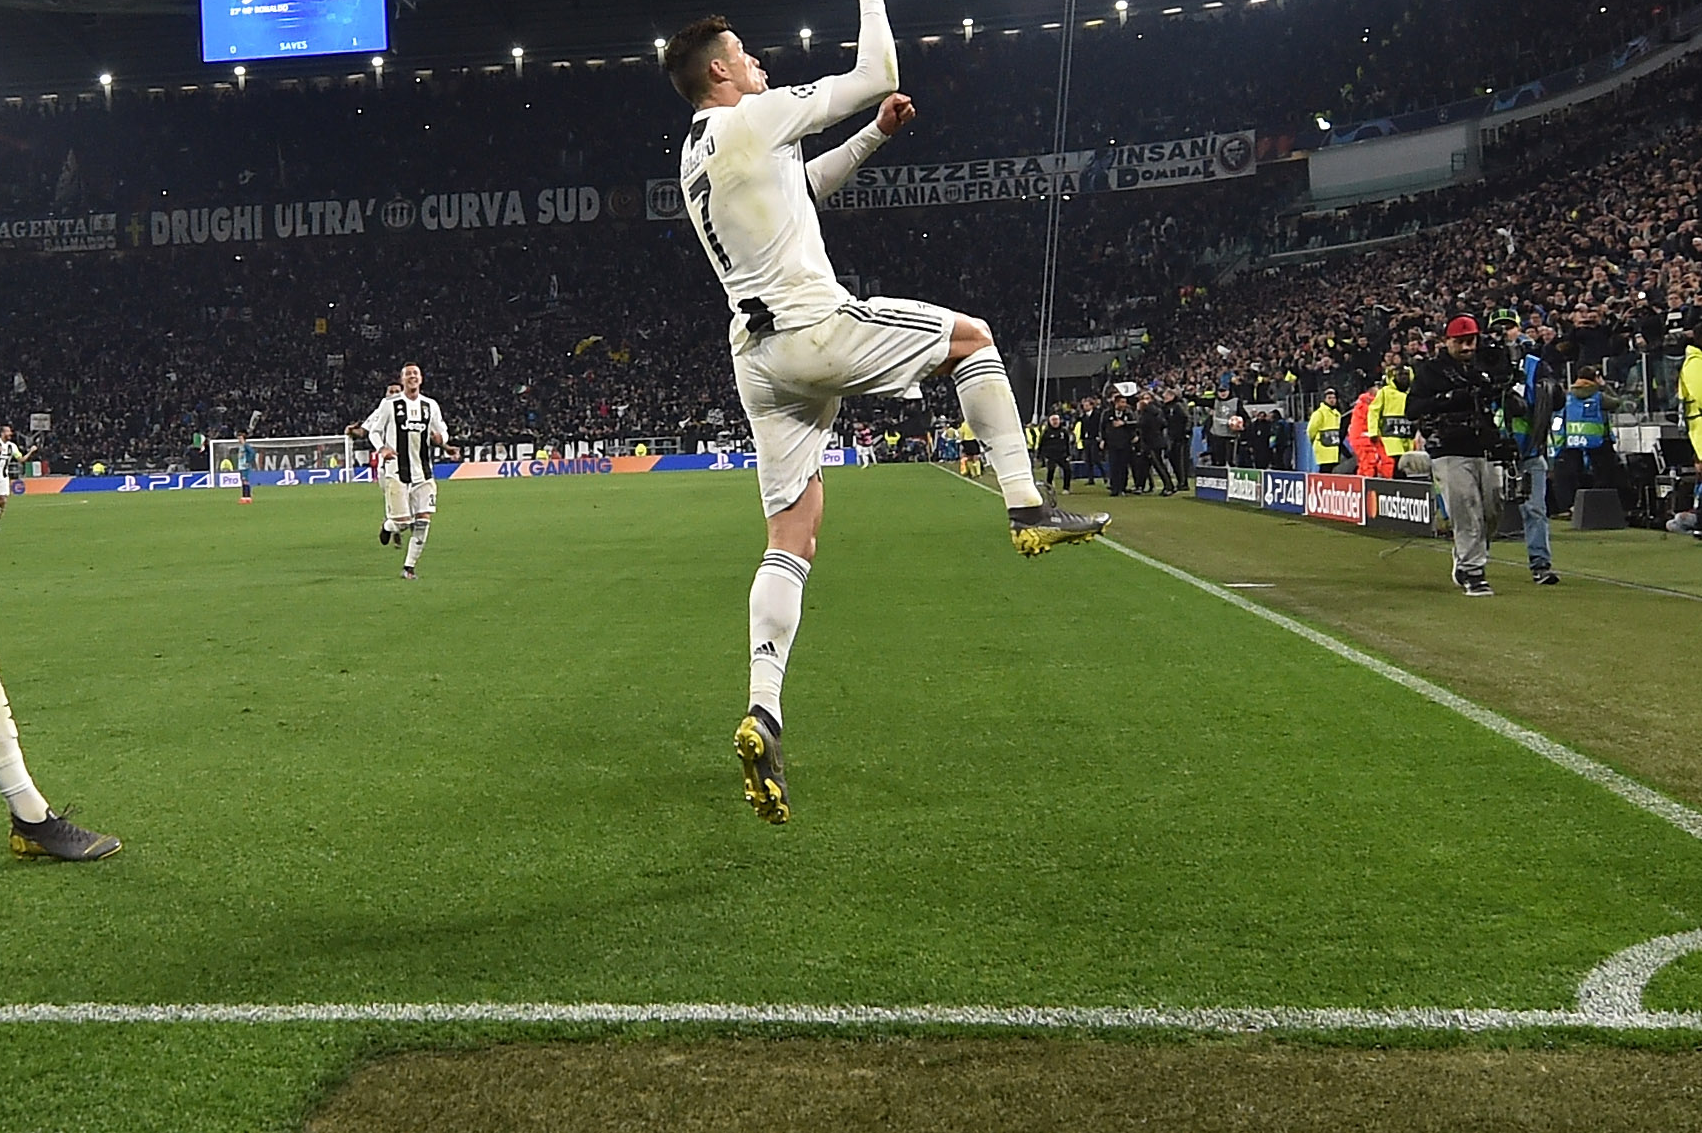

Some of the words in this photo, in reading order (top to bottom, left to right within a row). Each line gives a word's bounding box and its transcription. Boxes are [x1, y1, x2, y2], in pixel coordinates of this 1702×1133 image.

[279, 41, 308, 51] SAVES
[856, 157, 1043, 188] SVIZZERA
[828, 186, 942, 209] GERMANIA
[963, 173, 1076, 202] FRANCIA
[151, 205, 263, 246] DRUGHI
[274, 198, 378, 239] ULTRA'
[421, 190, 527, 230] CURVA
[537, 186, 601, 225] SUD
[688, 172, 732, 272] 7
[401, 420, 427, 433] Jeep
[1570, 423, 1585, 433] TV
[498, 461, 523, 478] 4K
[529, 457, 613, 476] GAMING
[822, 453, 841, 463] Pro
[149, 473, 213, 491] PS4
[223, 475, 239, 485] Pro
[1274, 479, 1295, 504] PS4
[1316, 480, 1362, 519] Santander
[1378, 491, 1430, 524] mastercard
